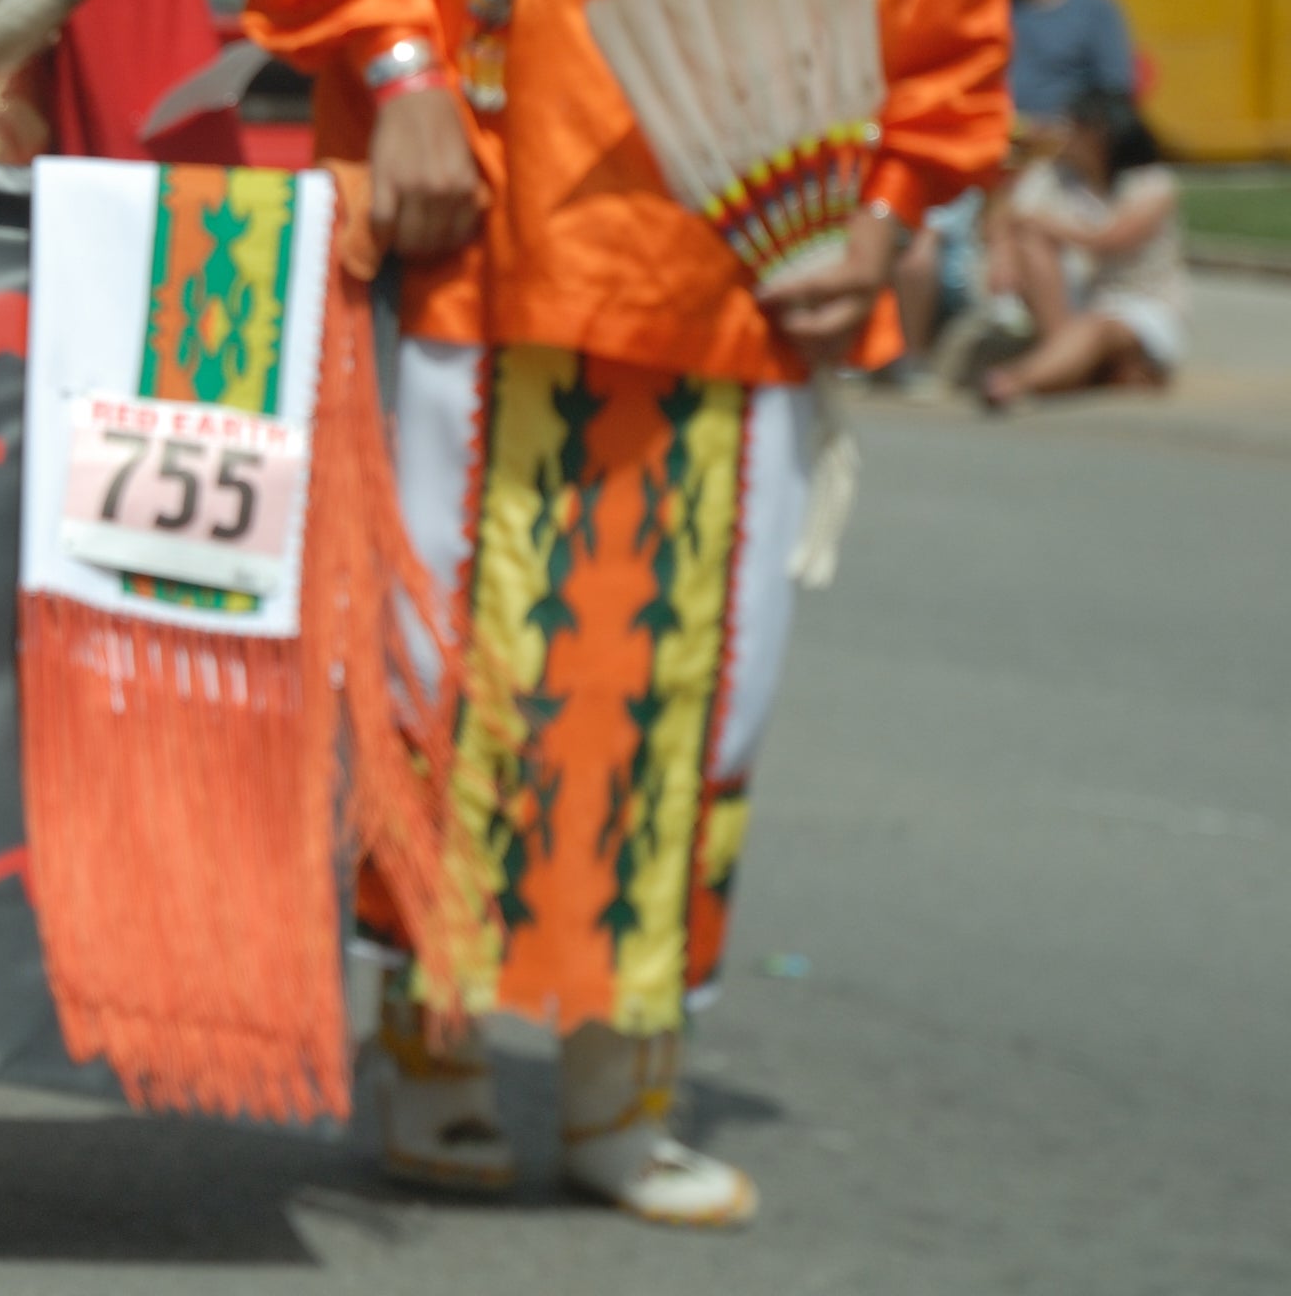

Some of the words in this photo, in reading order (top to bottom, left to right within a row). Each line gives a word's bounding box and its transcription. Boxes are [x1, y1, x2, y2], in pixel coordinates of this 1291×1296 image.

[91, 401, 159, 432] RED
[172, 412, 288, 446] EARTH
[100, 431, 265, 540] 755
